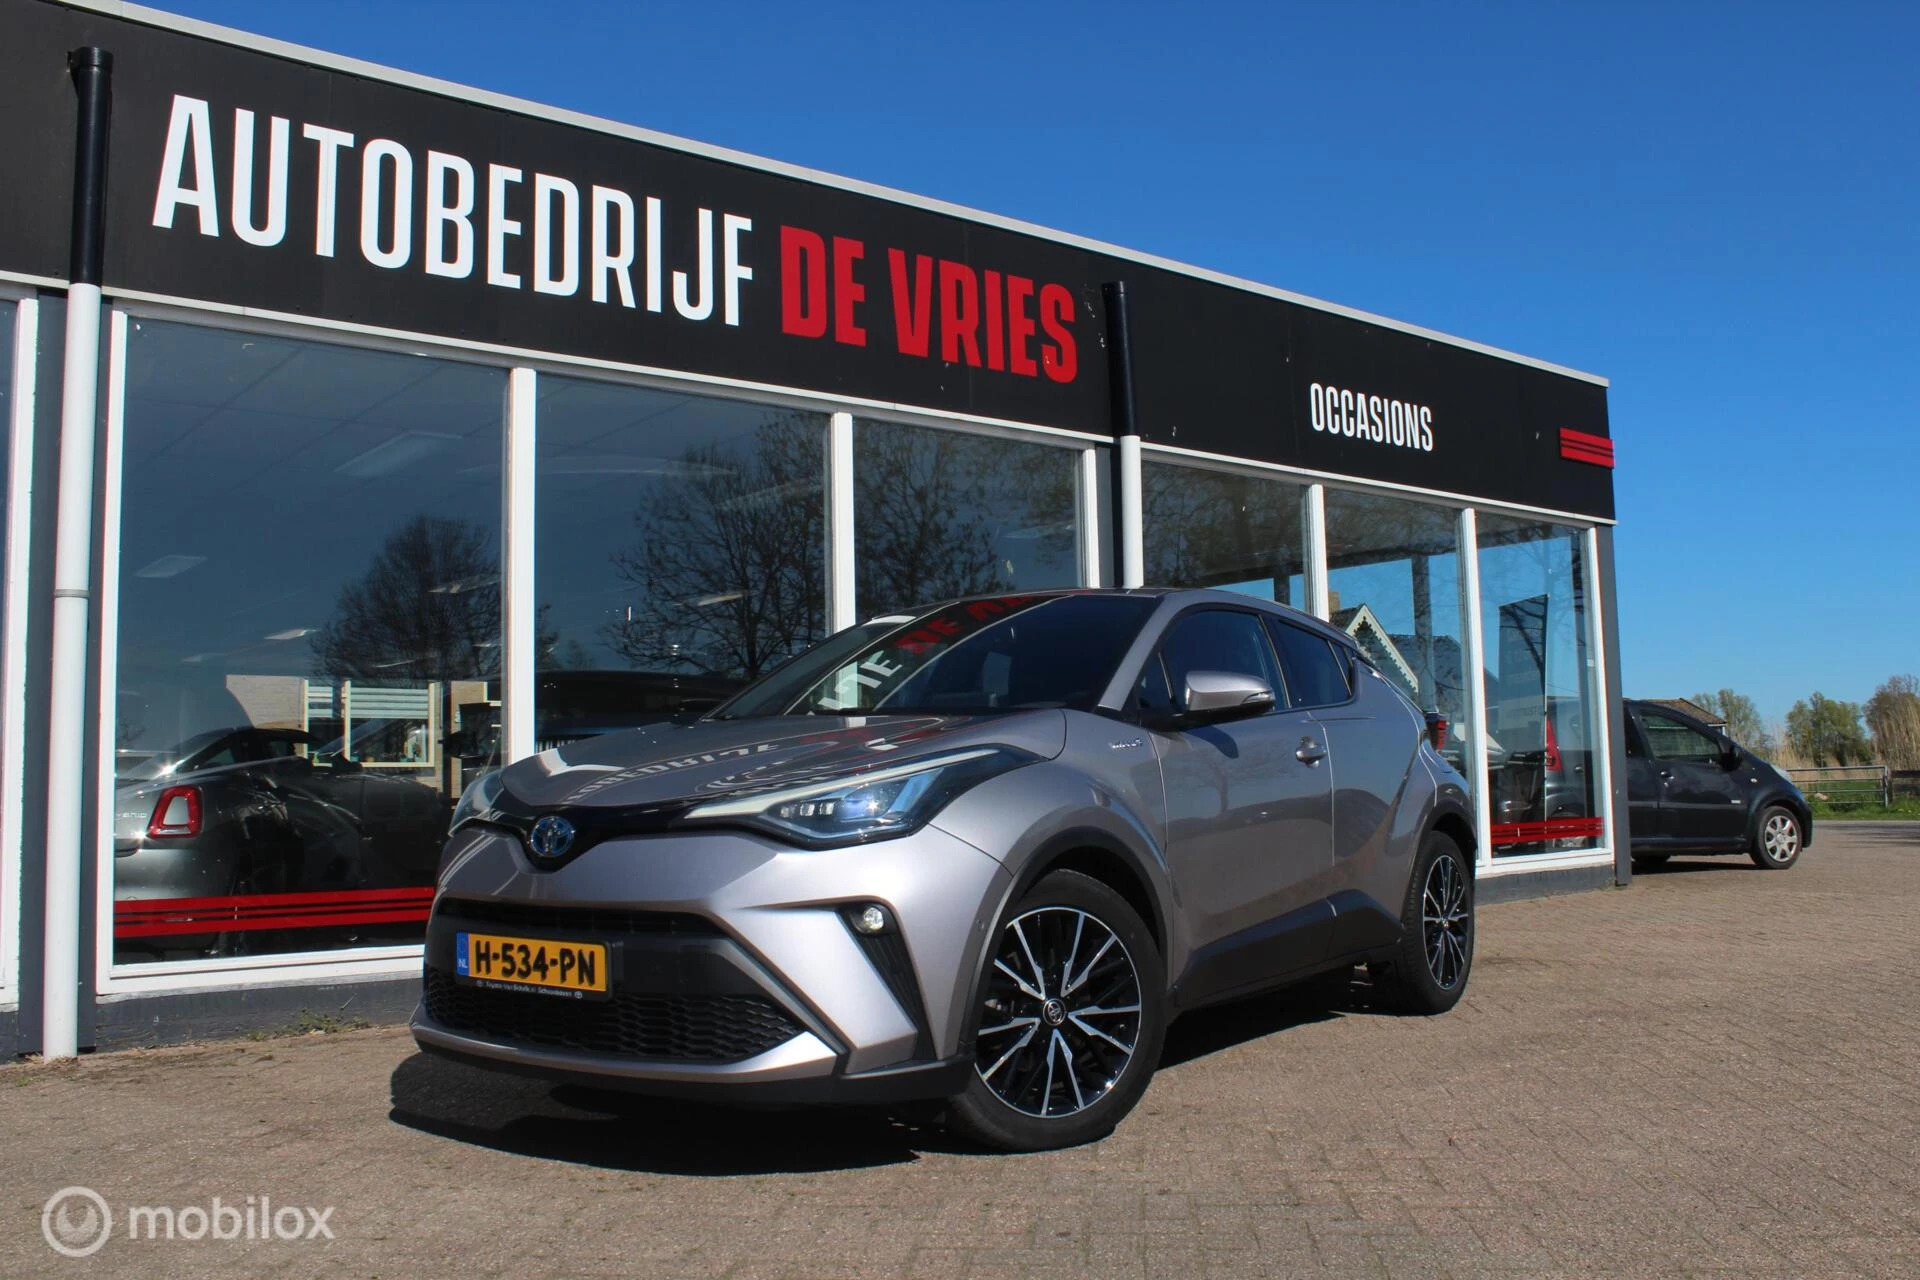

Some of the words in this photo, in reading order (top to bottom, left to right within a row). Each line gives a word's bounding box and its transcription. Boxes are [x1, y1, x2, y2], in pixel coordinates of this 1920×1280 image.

[152, 94, 754, 326] AUTOBEDRIJF
[779, 224, 868, 347] DE
[887, 247, 1078, 384] VRIES
[1310, 382, 1434, 453] OCCASIONS
[457, 958, 469, 969] NL
[475, 940, 596, 987] H-534-PN
